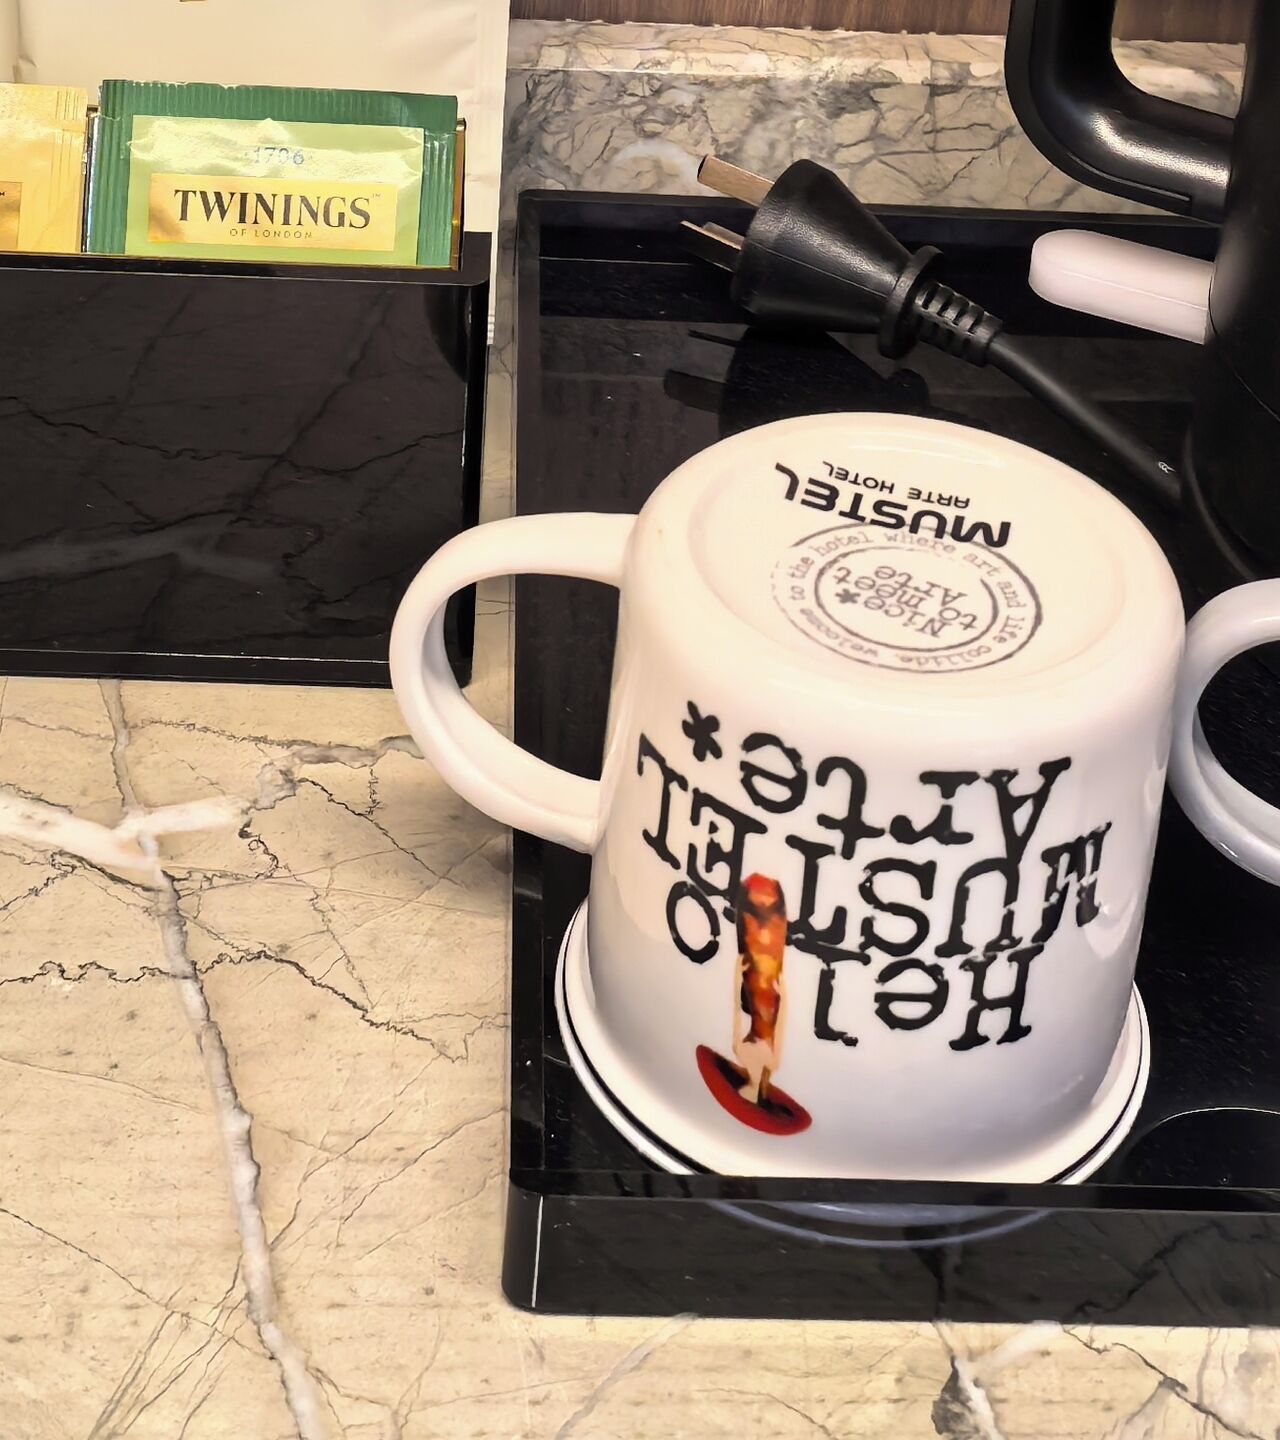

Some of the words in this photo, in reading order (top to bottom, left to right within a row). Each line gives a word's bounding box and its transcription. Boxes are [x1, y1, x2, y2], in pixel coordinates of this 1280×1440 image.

[229, 228, 248, 238] OF
[255, 229, 313, 240] LONDON
[822, 461, 895, 494] HOTEL
[775, 462, 1012, 548] MUSTEL
[907, 487, 971, 509] ARTE
[809, 531, 874, 558] hotel
[638, 732, 1113, 957] MUSTEL
